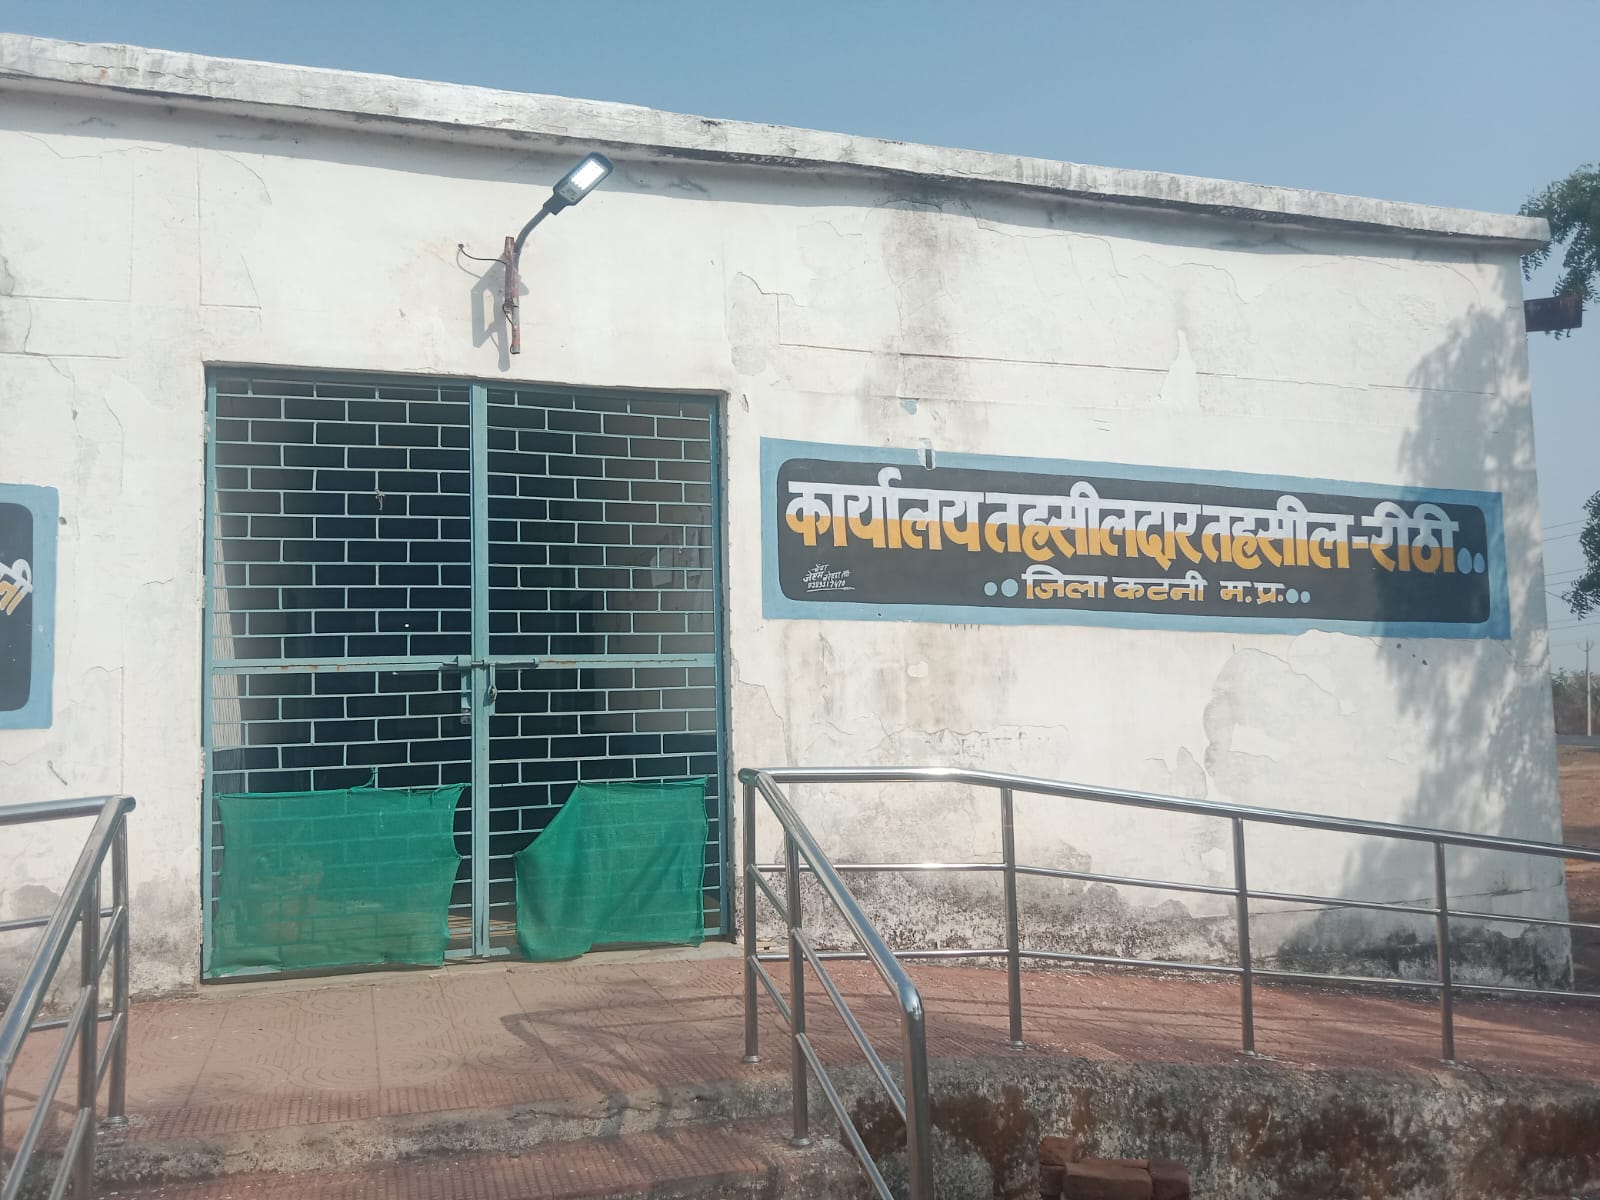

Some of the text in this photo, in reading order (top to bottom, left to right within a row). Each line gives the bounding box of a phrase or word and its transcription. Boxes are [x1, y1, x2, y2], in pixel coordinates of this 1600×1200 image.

[785, 467, 983, 552] कार्यालय
[984, 481, 1202, 570] तहसीलदार
[1022, 565, 1108, 599] जिला
[1112, 570, 1208, 602] कटनी
